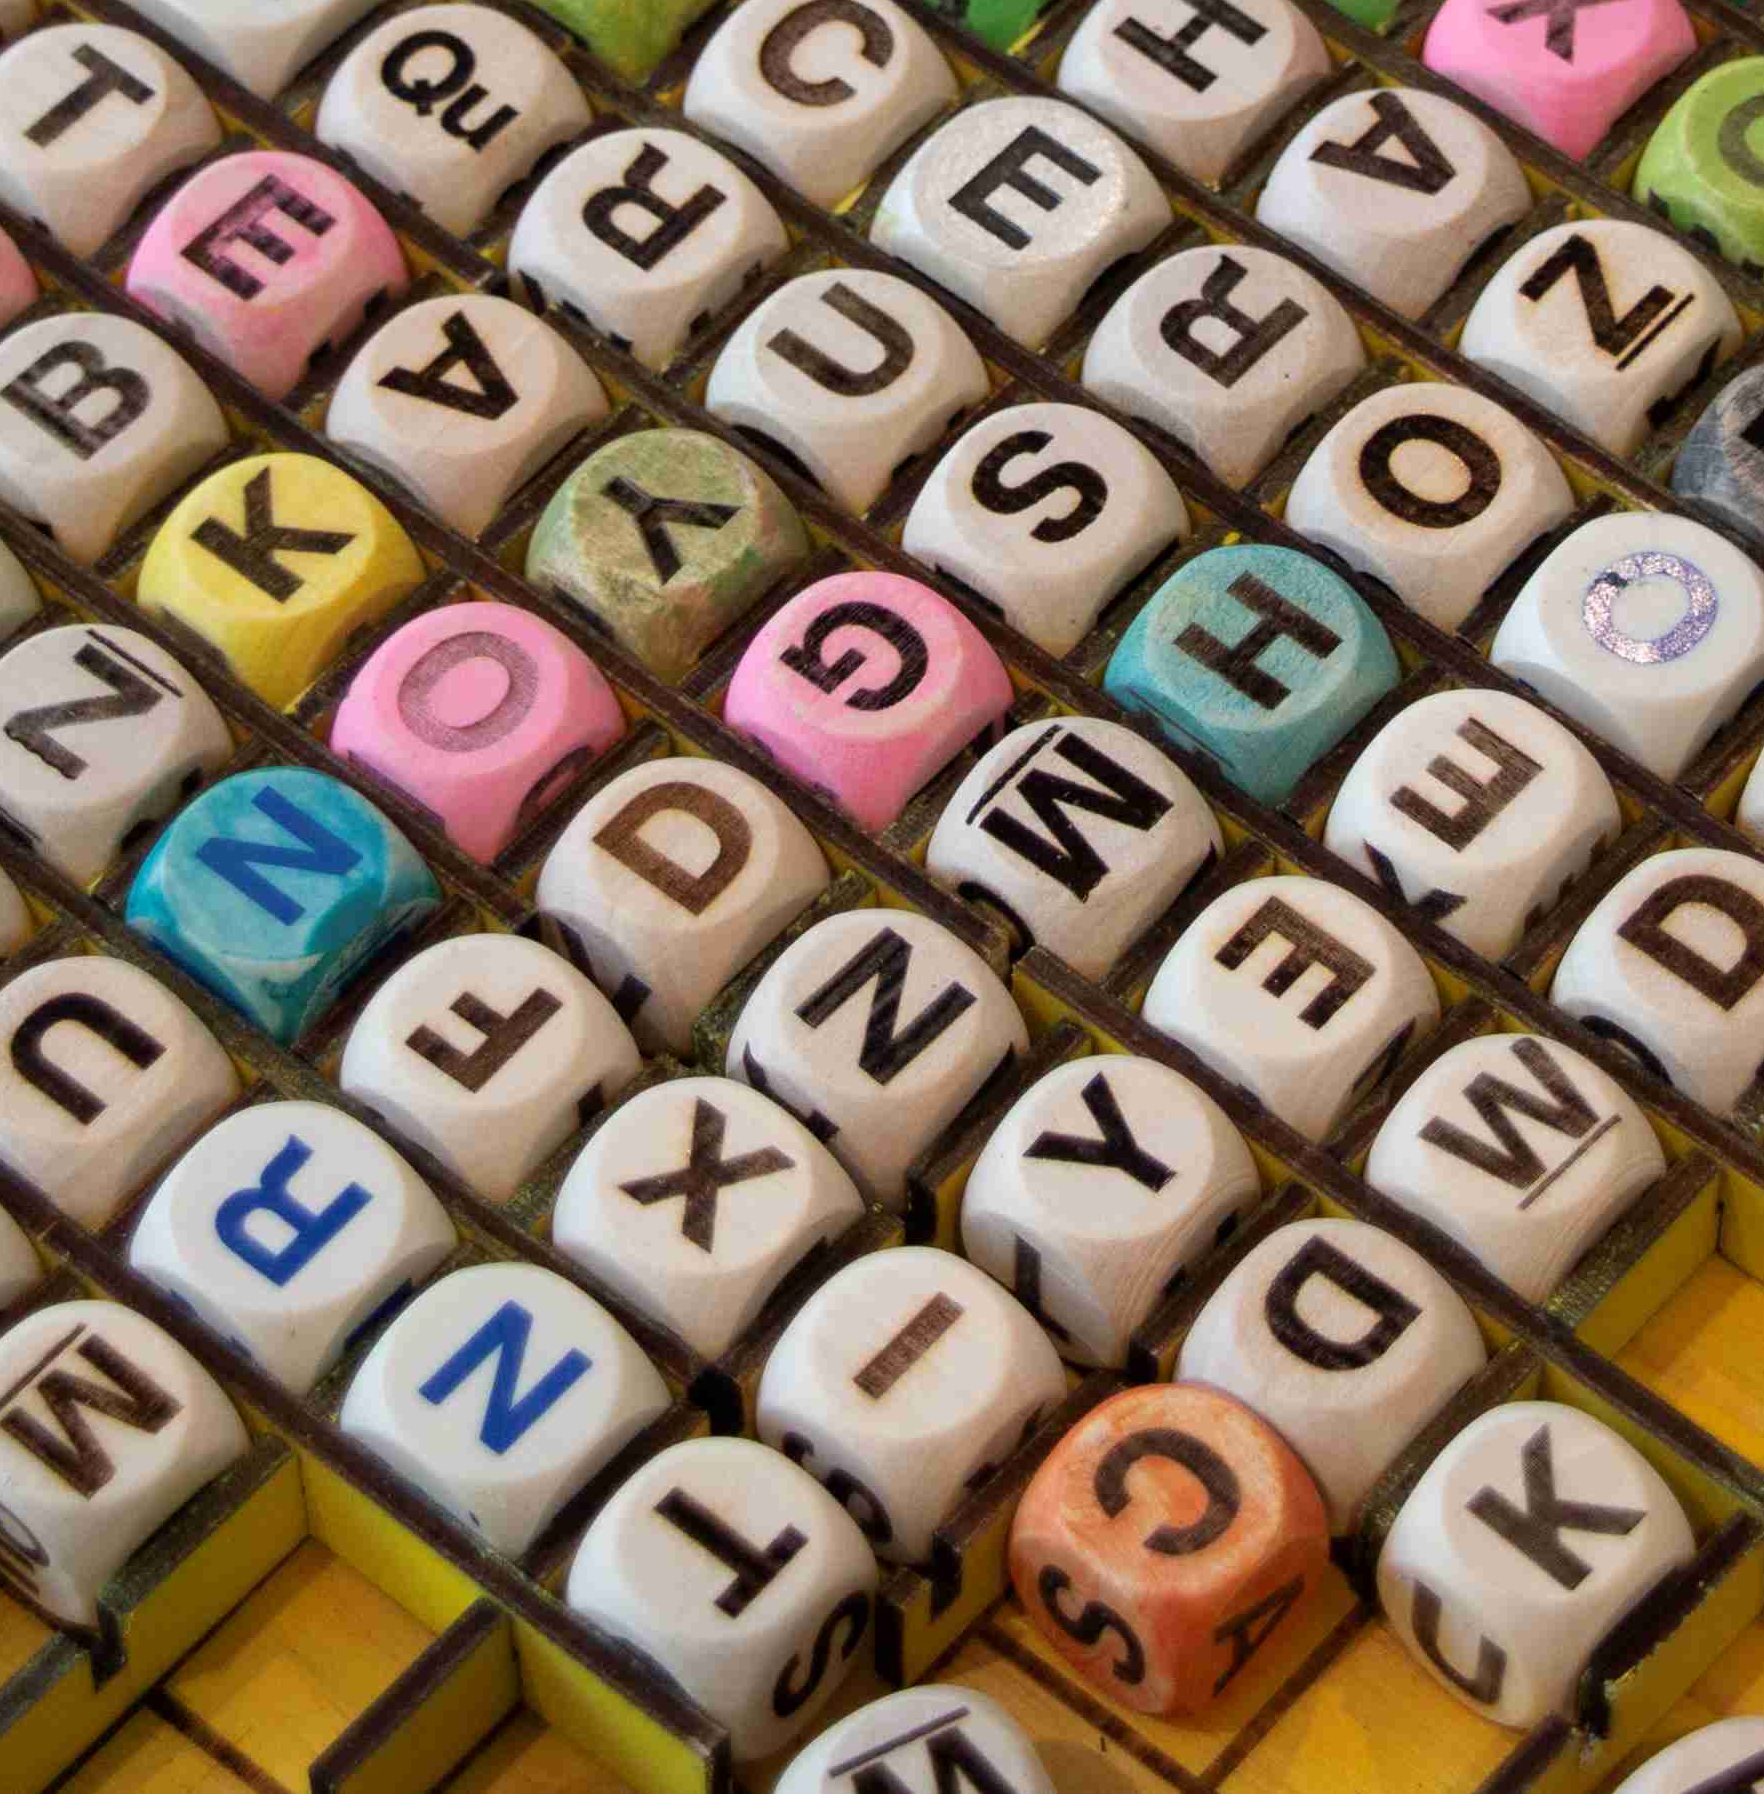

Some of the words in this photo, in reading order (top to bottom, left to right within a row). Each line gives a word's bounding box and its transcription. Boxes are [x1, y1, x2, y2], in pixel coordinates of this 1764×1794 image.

[25, 44, 154, 146] T
[1310, 91, 1455, 194] A
[582, 143, 726, 270] R
[948, 126, 1101, 250] E
[378, 312, 518, 420] A
[768, 283, 914, 397] U
[1160, 255, 1308, 388] R
[600, 477, 739, 584] Y
[972, 431, 1107, 542] S
[1359, 414, 1501, 528] O
[191, 468, 354, 602] K
[781, 602, 928, 710] G
[1175, 574, 1341, 710] H
[1390, 717, 1543, 852] E
[1215, 897, 1374, 1030] E
[10, 993, 164, 1125] U
[406, 989, 561, 1092] F
[620, 1100, 792, 1252] X
[1026, 1074, 1175, 1192] Y
[215, 1137, 370, 1286] R
[1265, 1238, 1420, 1371] D
[655, 1490, 806, 1618] T
[1468, 1430, 1645, 1590] K
